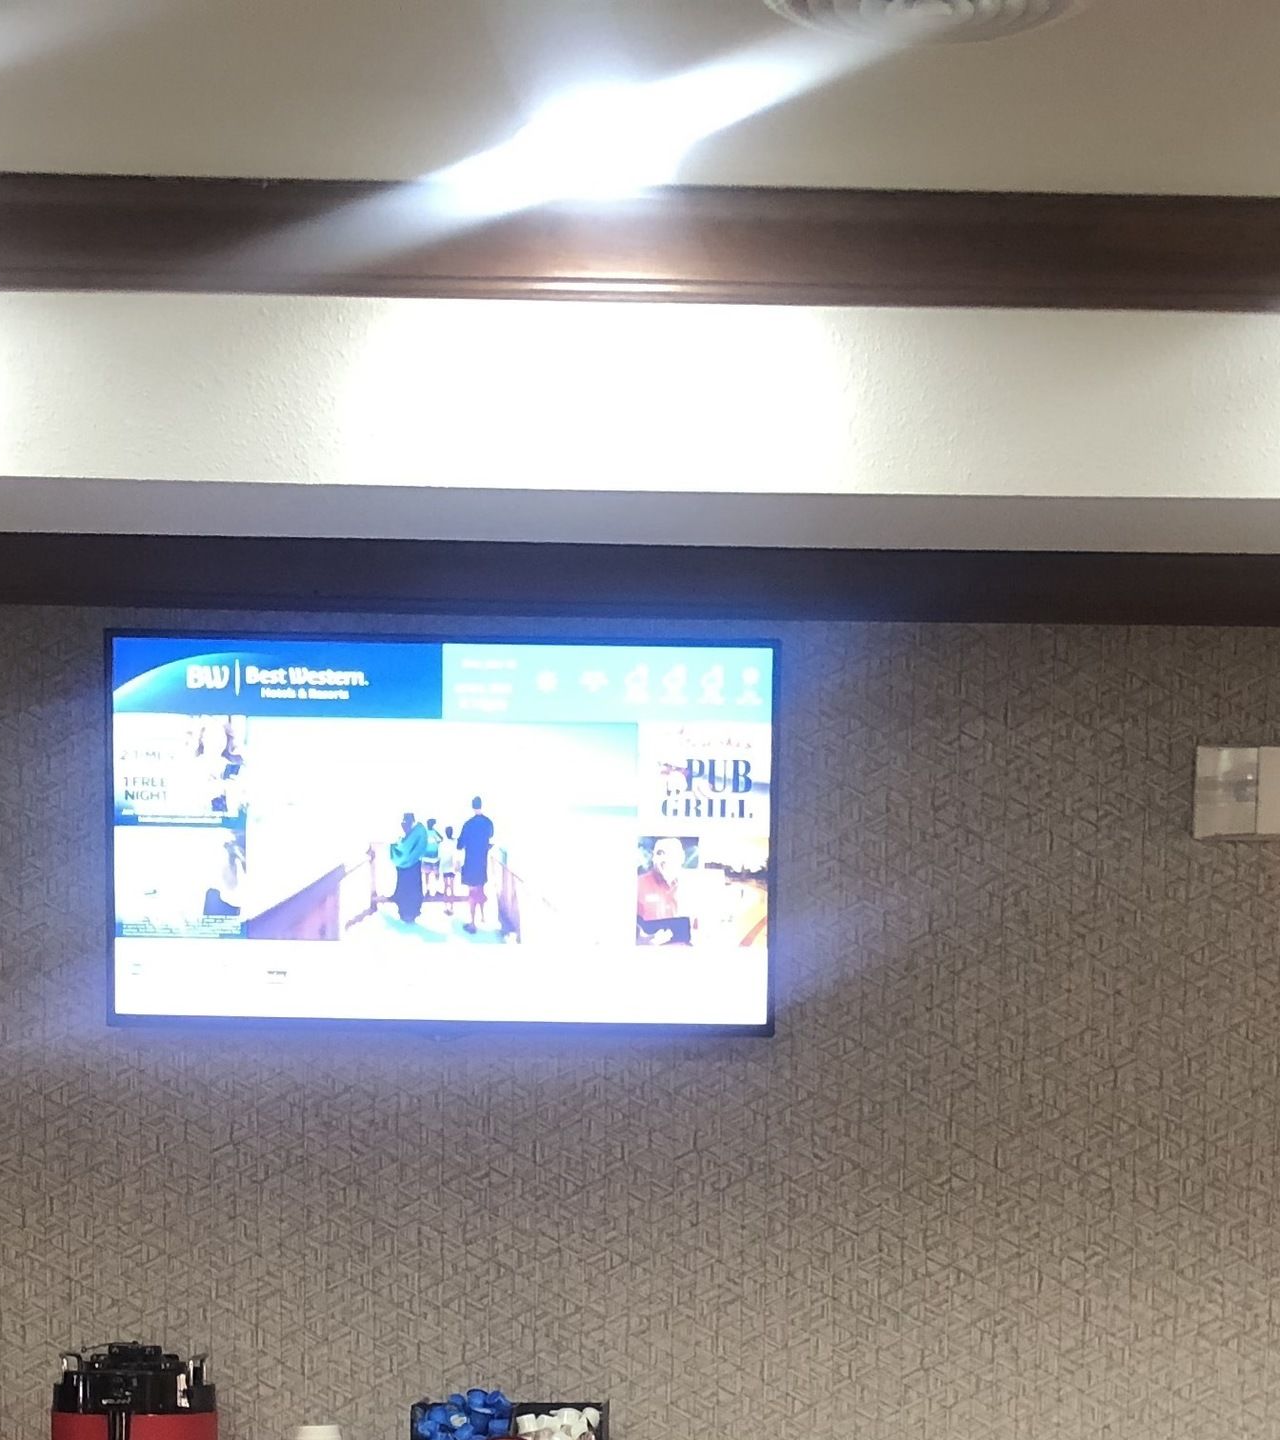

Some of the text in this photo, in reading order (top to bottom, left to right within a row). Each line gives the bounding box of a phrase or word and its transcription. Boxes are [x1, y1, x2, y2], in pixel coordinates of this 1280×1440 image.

[245, 665, 287, 685] Best
[685, 758, 753, 793] PUB
[124, 789, 168, 801] NIGHT
[661, 798, 754, 819] GRILL
